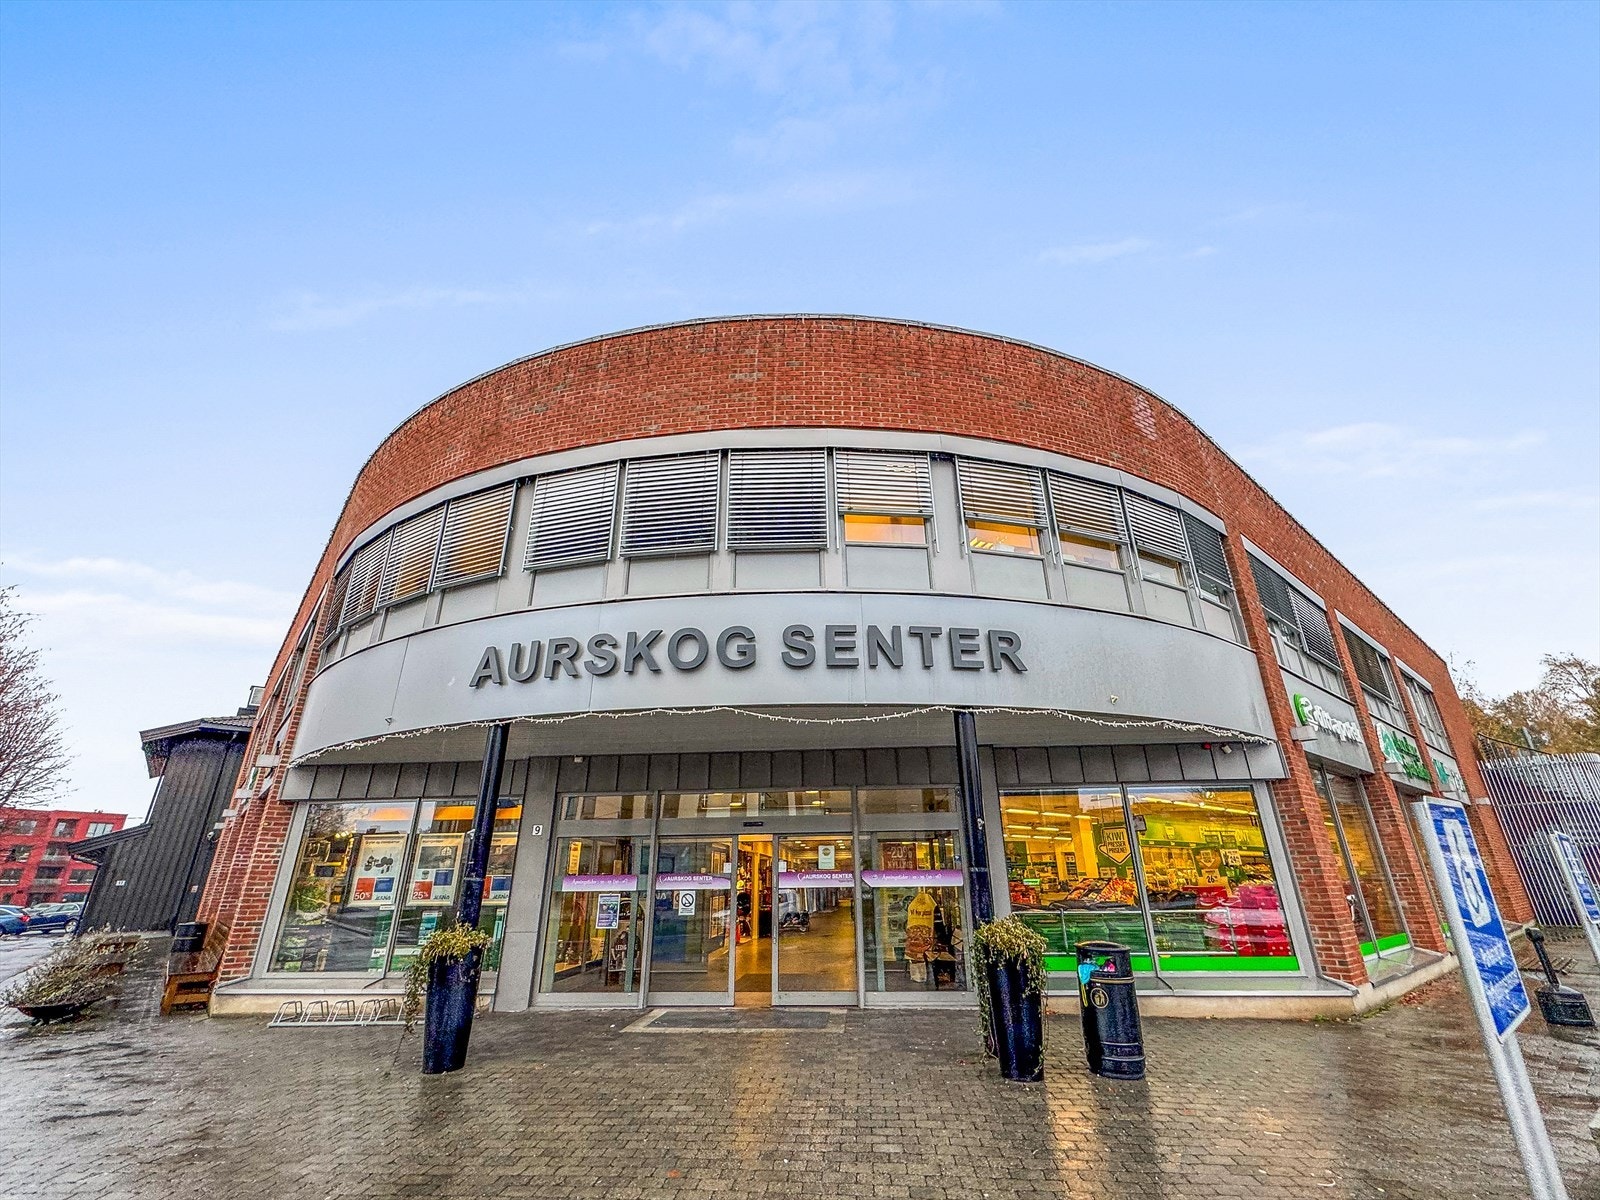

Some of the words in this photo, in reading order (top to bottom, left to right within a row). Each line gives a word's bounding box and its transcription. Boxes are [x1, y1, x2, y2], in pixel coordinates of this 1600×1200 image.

[469, 626, 756, 688] AURSKOG
[781, 624, 1028, 673] SENTER
[1106, 831, 1125, 841] KIWI
[354, 891, 371, 900] 50%
[413, 891, 429, 900] 25%
